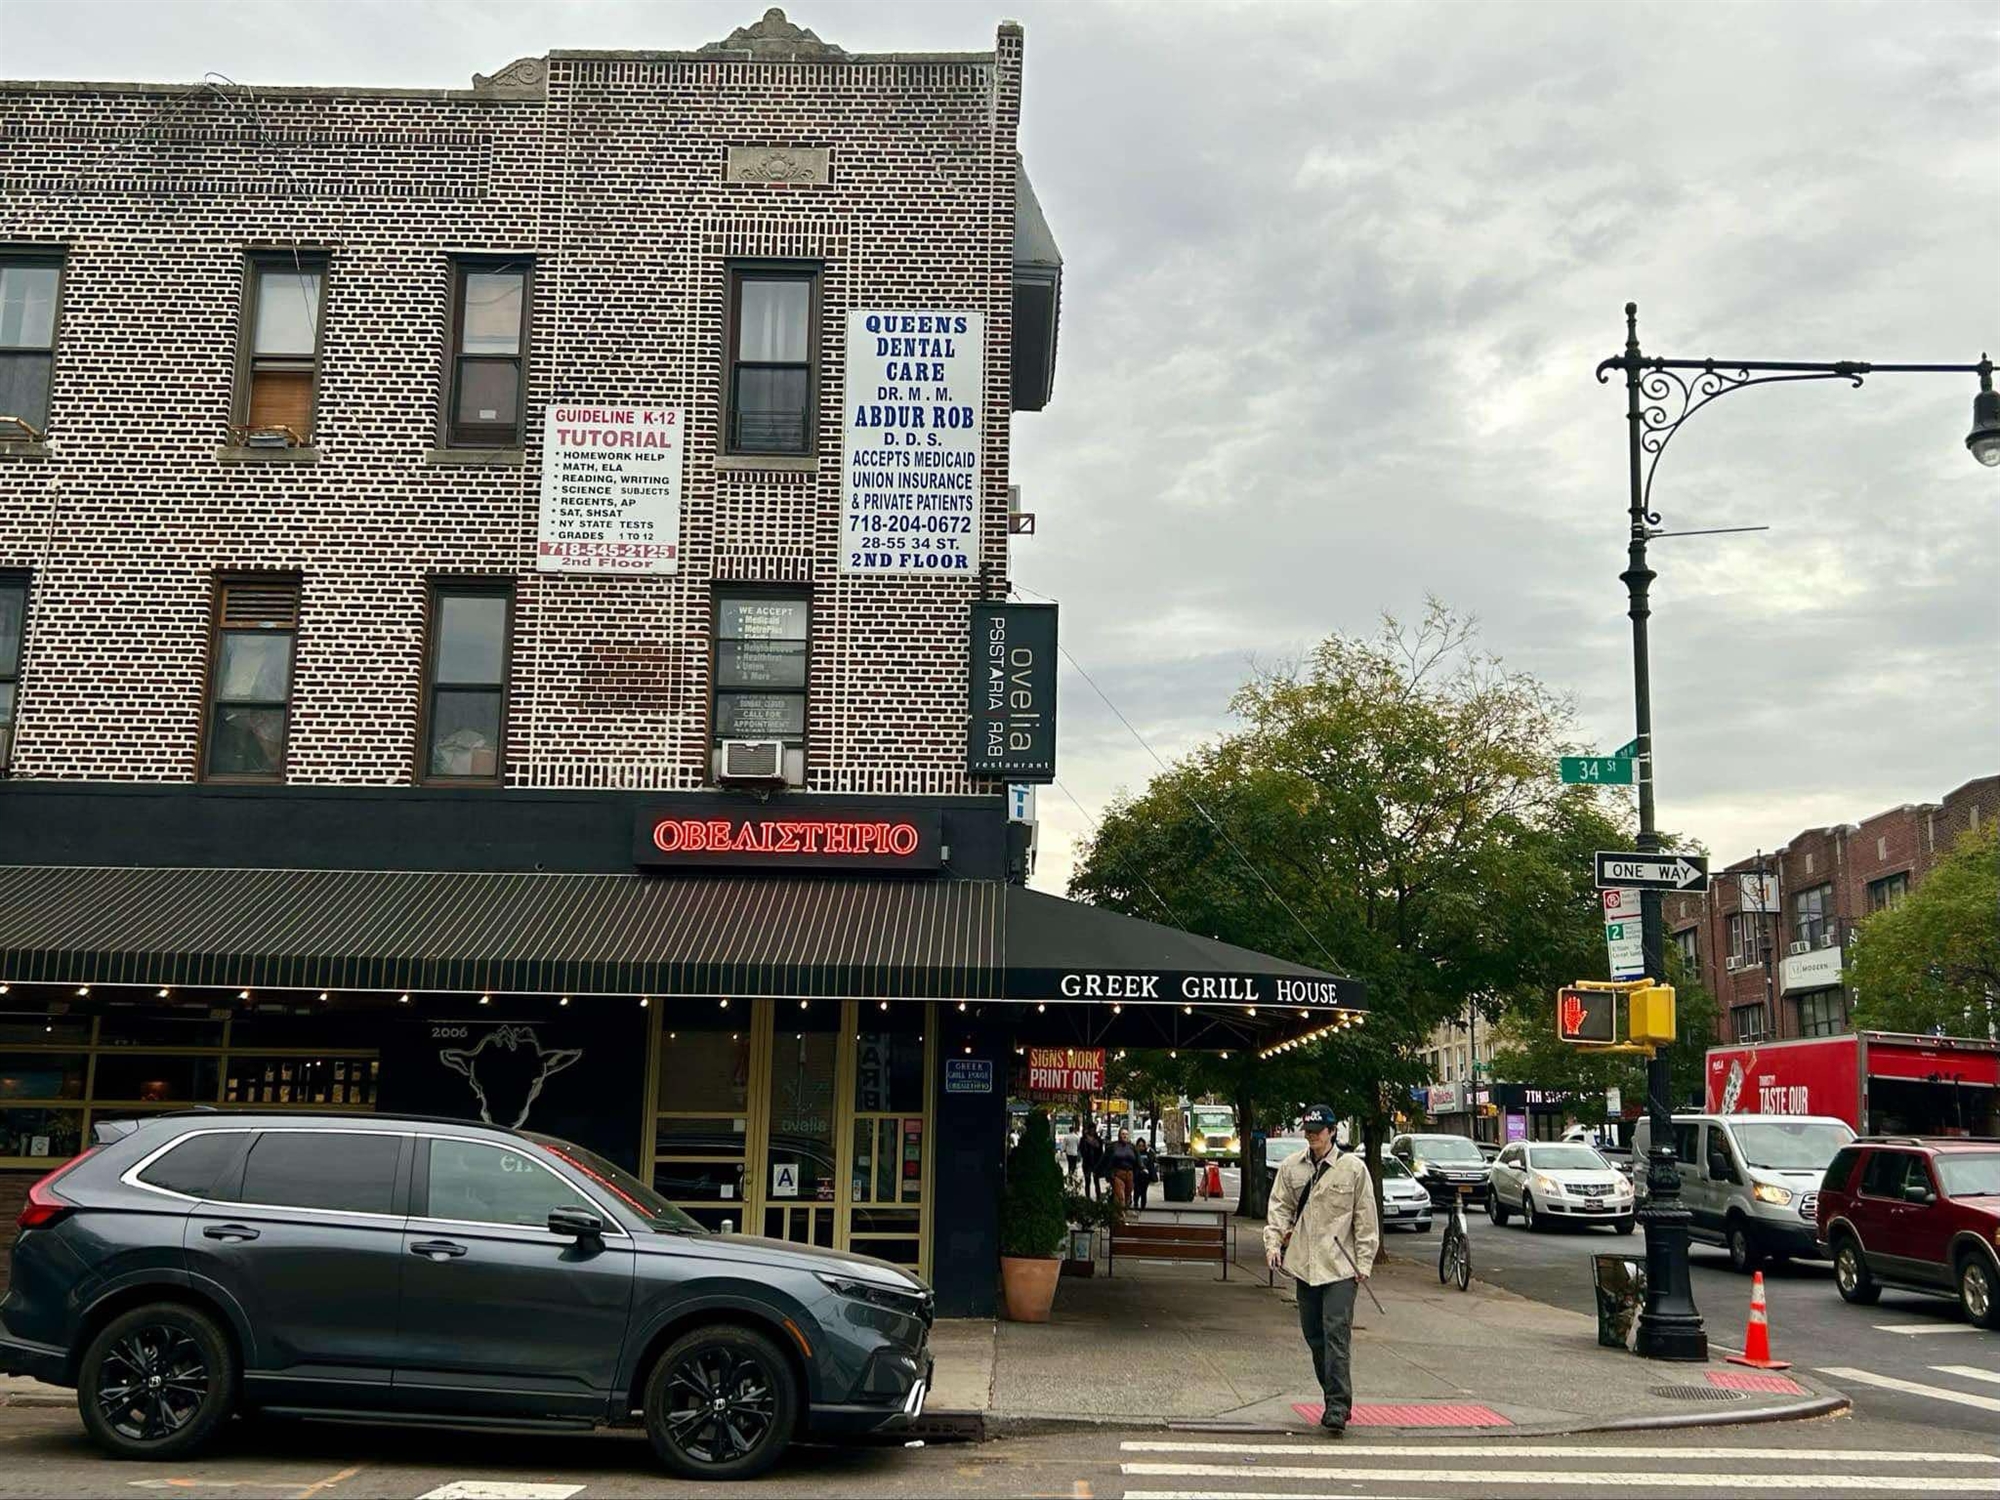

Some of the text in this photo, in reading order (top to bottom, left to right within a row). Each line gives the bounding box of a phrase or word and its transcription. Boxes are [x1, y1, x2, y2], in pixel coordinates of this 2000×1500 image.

[866, 315, 967, 334] QUEENS
[876, 337, 955, 358] DENTAL
[886, 362, 945, 382] CARE
[878, 386, 903, 401] DR.
[935, 387, 952, 402] M.
[555, 409, 675, 425] GUIDELINE K-12
[855, 405, 974, 429] ABDUR ROB
[557, 429, 671, 449] TUTORIAL
[884, 432, 942, 447] D. D. S.
[563, 451, 665, 461] HOMEWORK HELP
[853, 450, 975, 468] ACCEPTS MEDICAID
[563, 463, 623, 472] MATH, ELA
[562, 475, 670, 484] READING, WRITING
[853, 471, 972, 489] UNION INSURANCE
[561, 486, 670, 496] SCIENCE SUBJECTS
[560, 497, 636, 507] REGENTS, AP
[851, 493, 973, 511] & PRIVATE PATIENTS
[560, 509, 623, 518] SAT, SHSAT
[559, 520, 654, 529] NY STATE TESTS
[849, 515, 971, 533] 718-204-0672
[558, 531, 604, 540] GRADES
[862, 537, 959, 550] 28-55 34 ST.
[548, 543, 670, 558] 718-545-2125
[561, 557, 653, 568] 2nd Floor
[851, 553, 968, 569] 2ND FLOOR
[739, 606, 793, 616] WE ACCEPT
[988, 617, 1005, 710] PSISTARIA
[1009, 649, 1040, 751] ovelia
[975, 761, 1049, 769] restaurant
[1579, 760, 1616, 780] 34 St
[1613, 864, 1691, 880] ONE WAY
[1612, 926, 1620, 939] 2
[1060, 974, 1338, 1004] GREEK GRILL HOUSE
[431, 1027, 468, 1038] 2006
[1030, 1068, 1103, 1090] PRINT ONE.
[1525, 1090, 1543, 1104] 7TH
[1759, 1086, 1809, 1115] TASTE OUR
[777, 1167, 794, 1187] A
